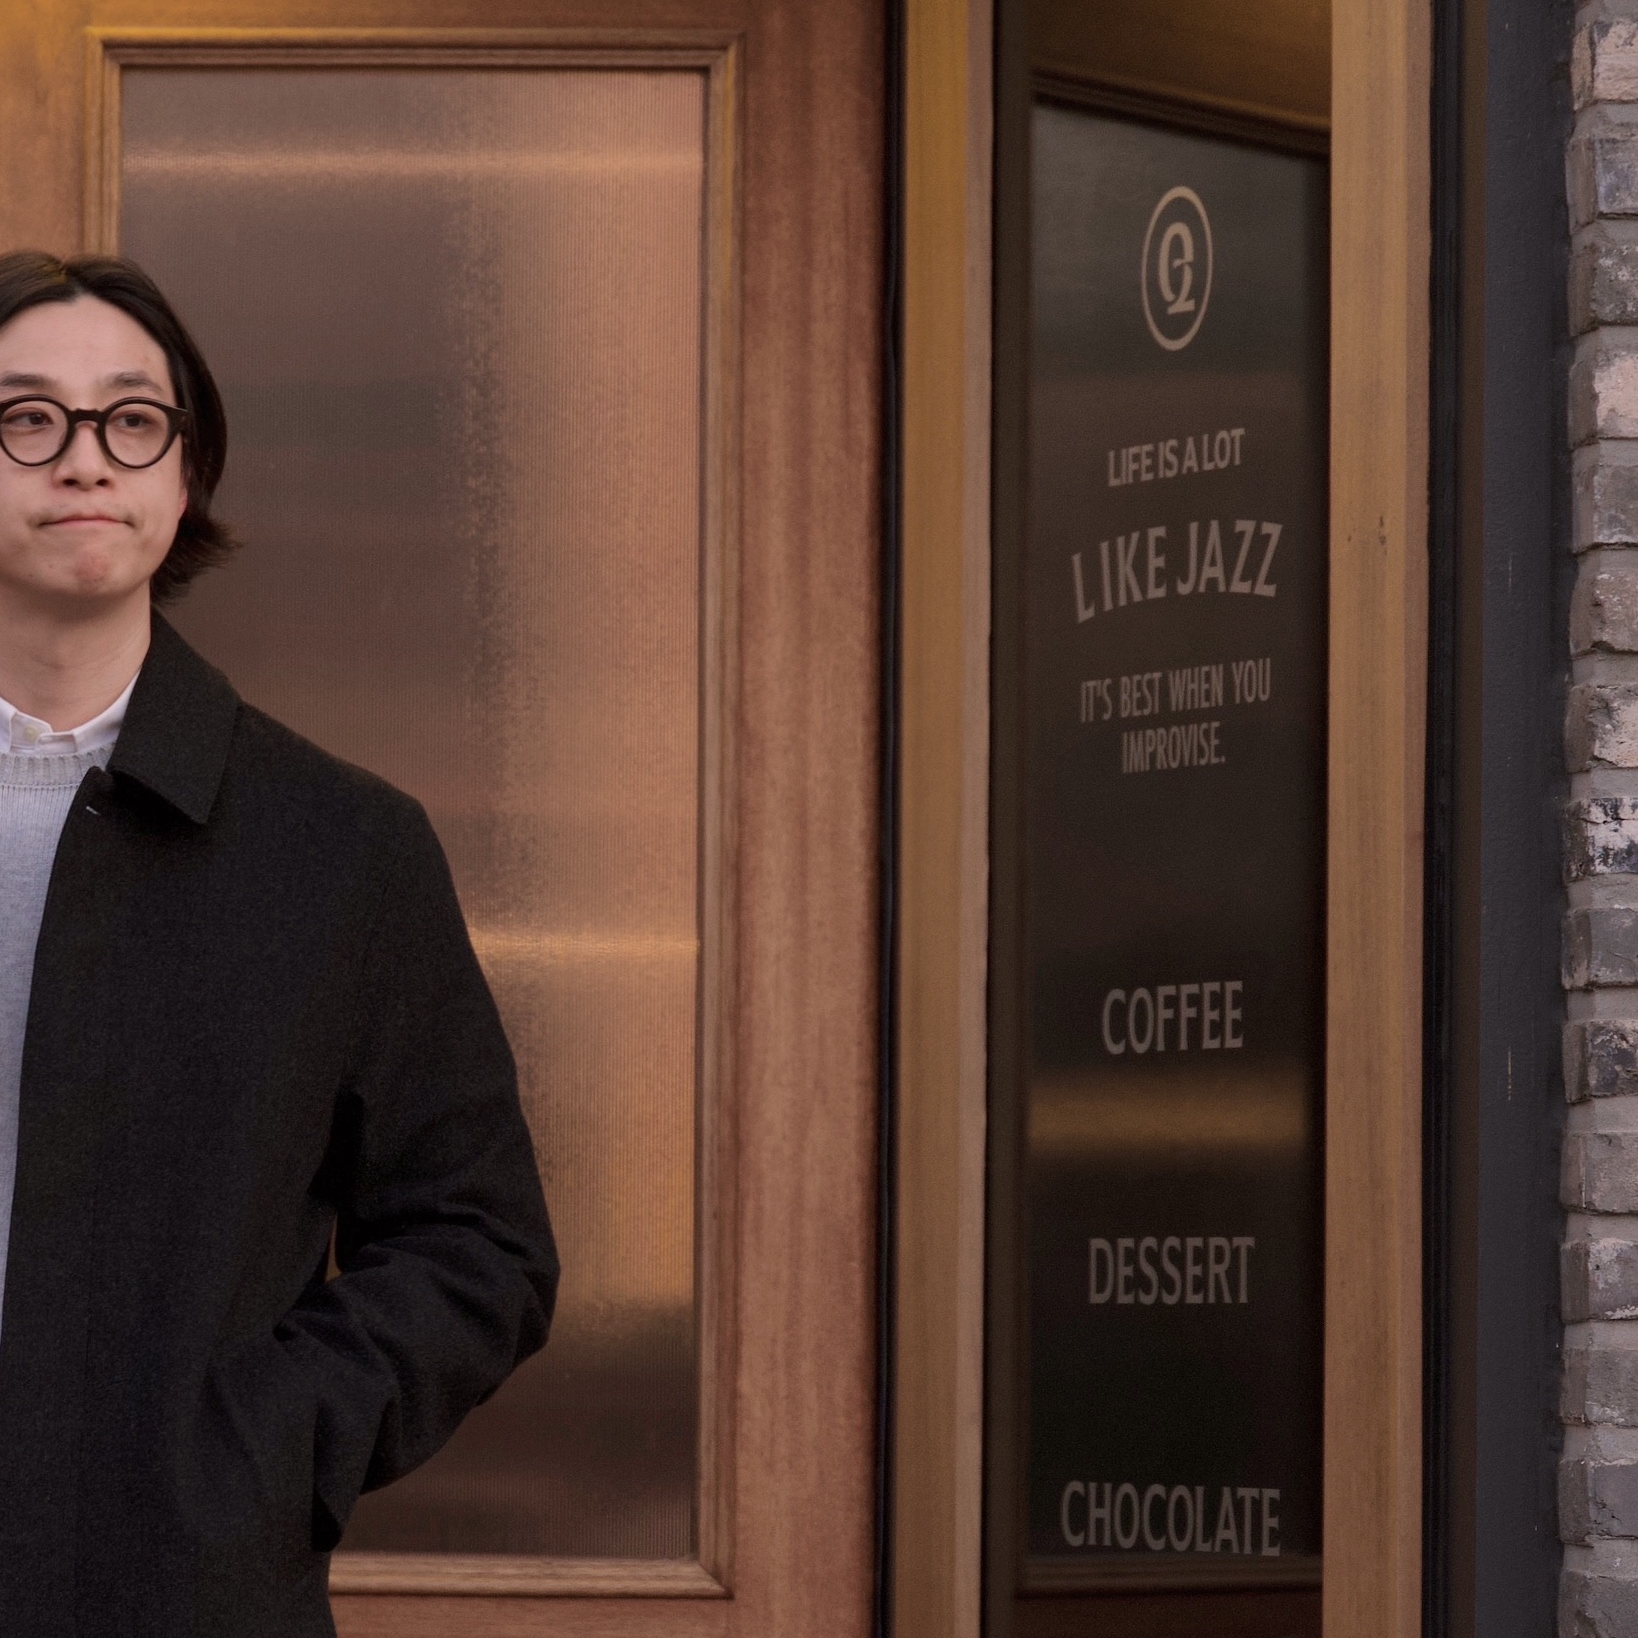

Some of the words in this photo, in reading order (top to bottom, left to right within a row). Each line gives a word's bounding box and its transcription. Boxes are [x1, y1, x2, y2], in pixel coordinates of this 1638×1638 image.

[1108, 443, 1155, 488] LIFE
[1158, 438, 1179, 479] IS
[1182, 436, 1199, 475] A
[1202, 427, 1245, 471] LOT
[1072, 526, 1167, 624] LIKE
[1177, 519, 1283, 598] JAZZ
[1081, 678, 1112, 724] IT'S
[1120, 671, 1162, 718] BEST
[1169, 663, 1223, 711] WHEN
[1232, 657, 1271, 704] YOU
[1123, 721, 1226, 774] IMPROVISE.
[1102, 980, 1244, 1055] COFFEE
[1088, 1236, 1255, 1305] DESSERT
[1060, 1480, 1281, 1557] CHOCOLATE
